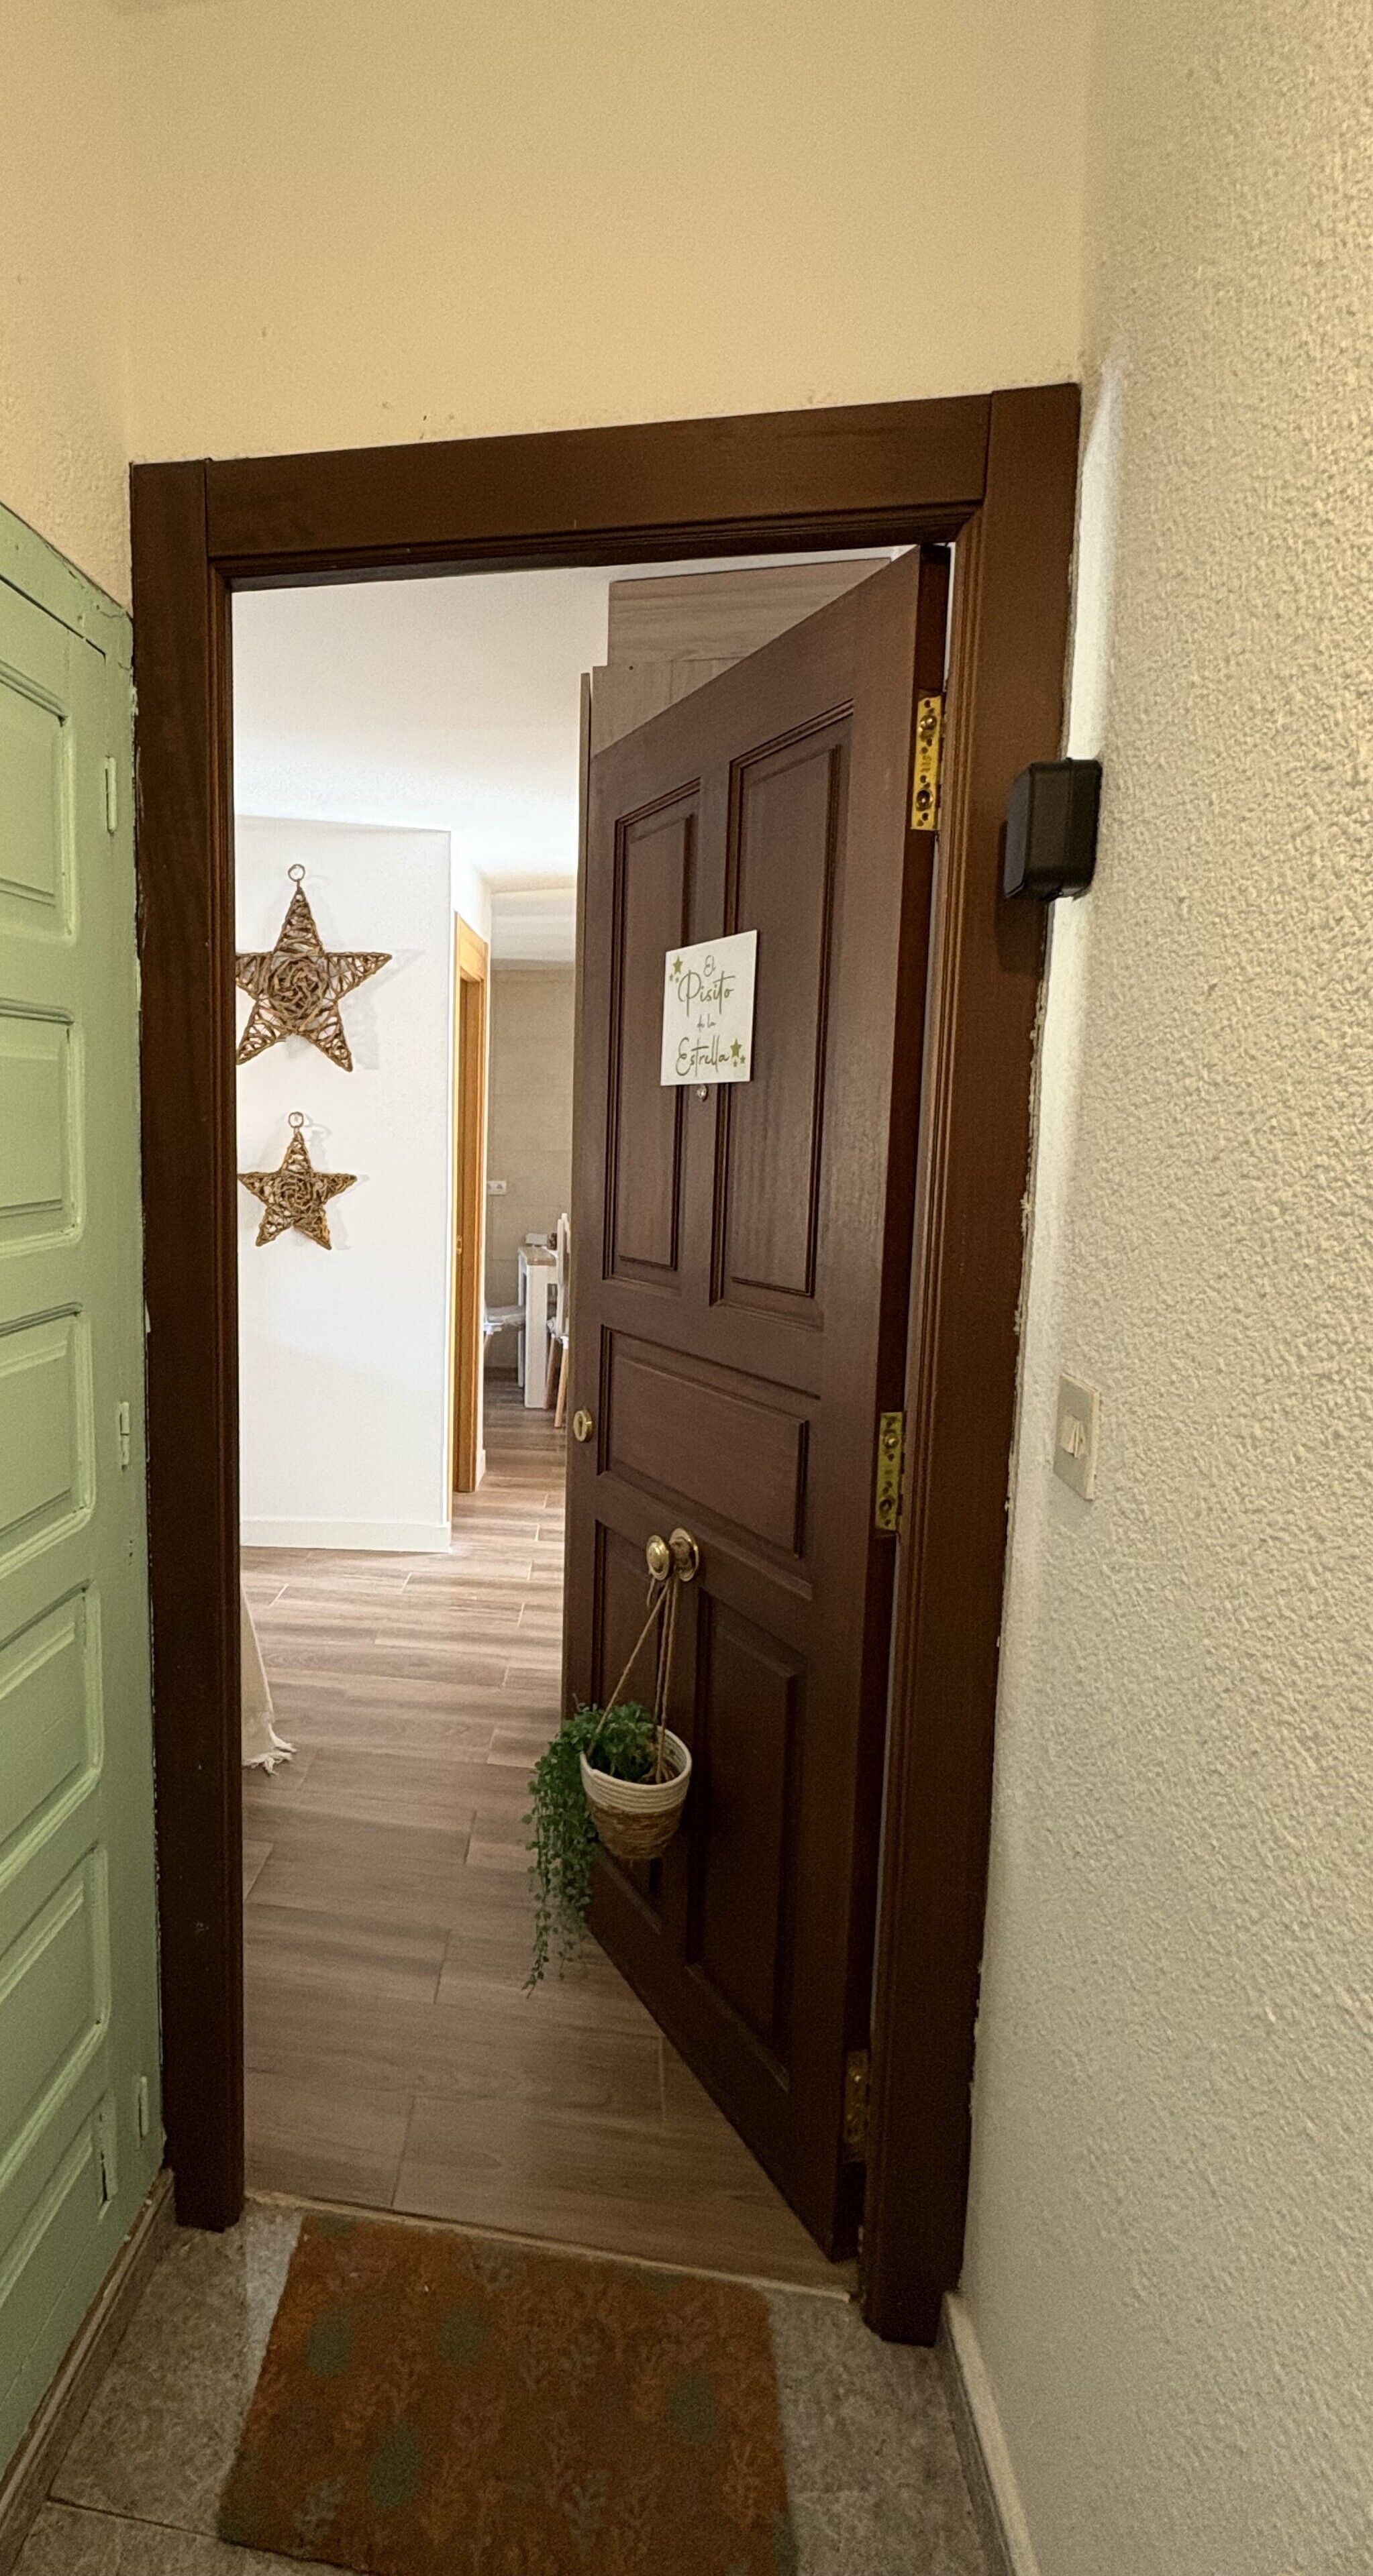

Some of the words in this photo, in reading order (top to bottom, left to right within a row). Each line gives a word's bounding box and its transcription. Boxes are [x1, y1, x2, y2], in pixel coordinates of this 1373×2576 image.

[703, 955, 716, 977] El
[678, 969, 735, 1017] Pisito
[707, 1013, 717, 1028] la
[676, 1034, 730, 1077] Estrella
